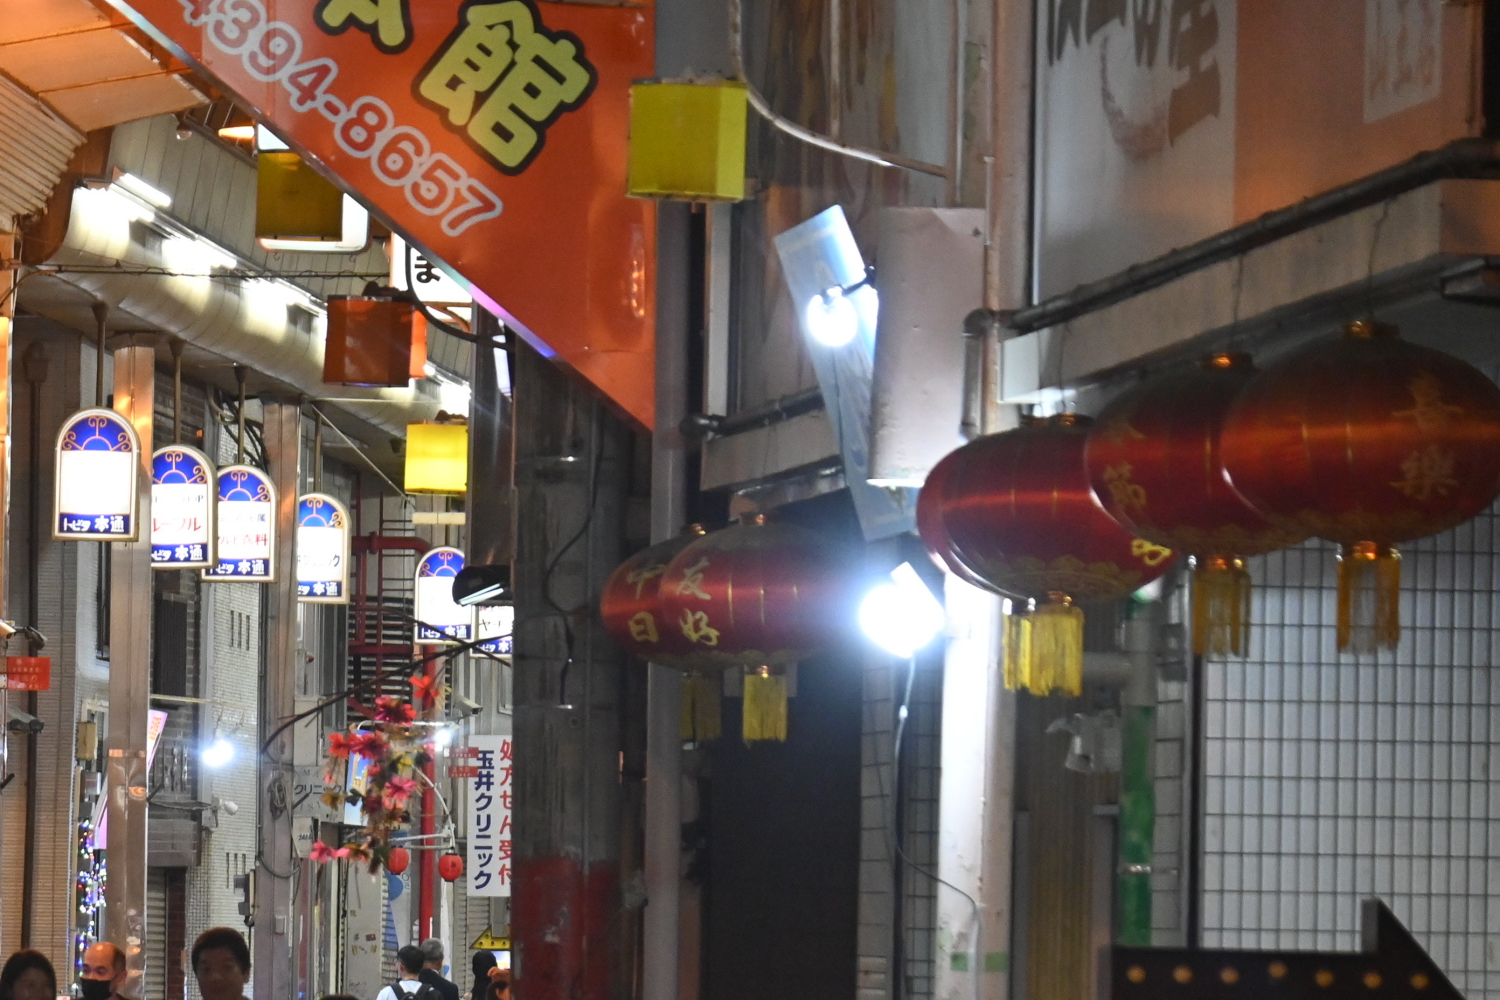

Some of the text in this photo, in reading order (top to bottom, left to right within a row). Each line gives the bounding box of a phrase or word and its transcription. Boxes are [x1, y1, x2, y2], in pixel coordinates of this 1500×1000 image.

[63, 515, 125, 532] トビタ本通
[151, 544, 203, 561] ビタ本通
[297, 582, 338, 597] ビタ本通
[474, 750, 494, 890] 玉井クリニック
